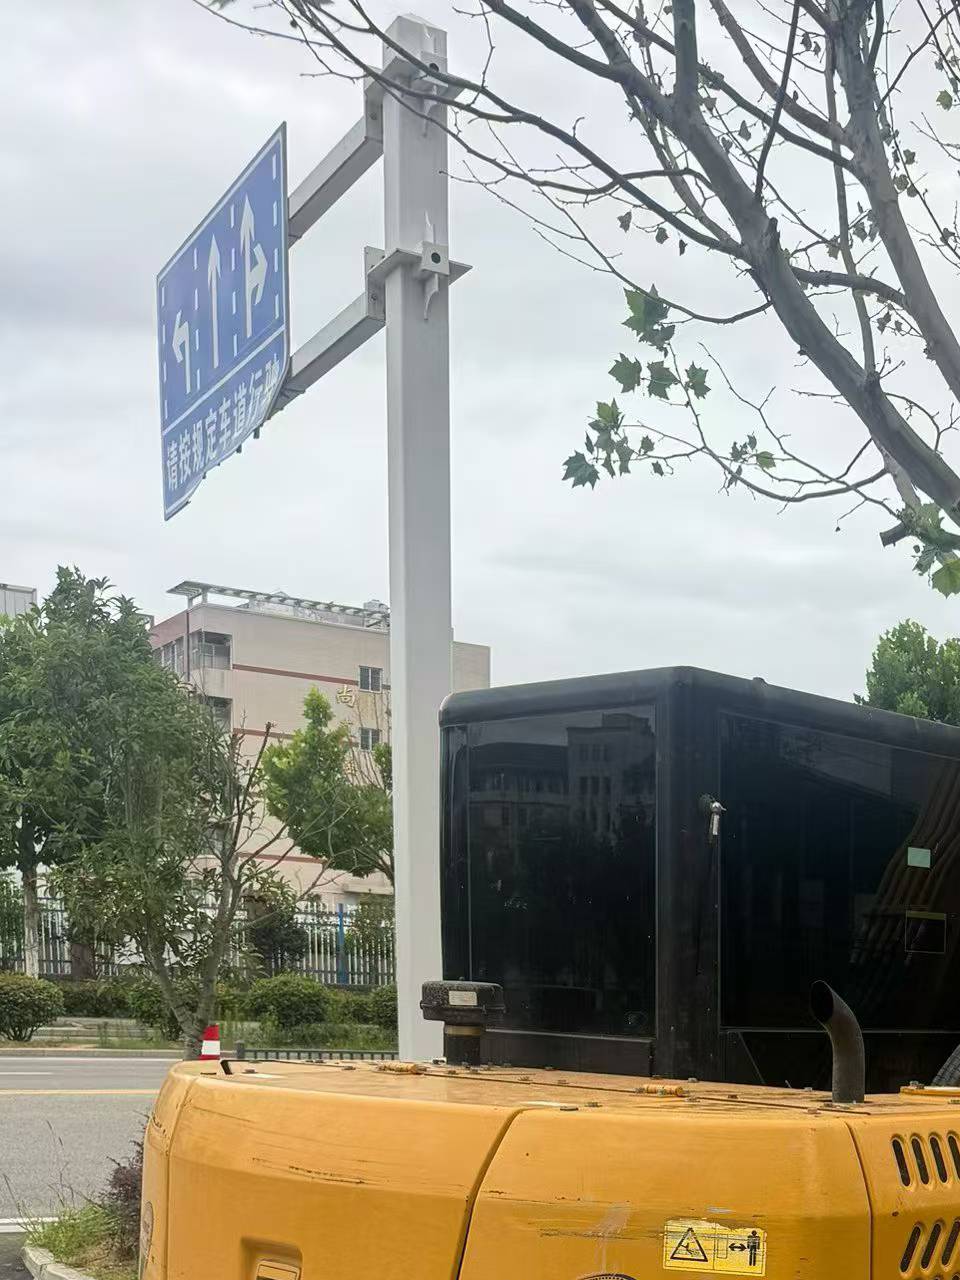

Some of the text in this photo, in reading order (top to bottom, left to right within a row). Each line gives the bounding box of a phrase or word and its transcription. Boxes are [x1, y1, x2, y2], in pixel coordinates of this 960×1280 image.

[166, 352, 281, 491] 请按规定车道行驶
